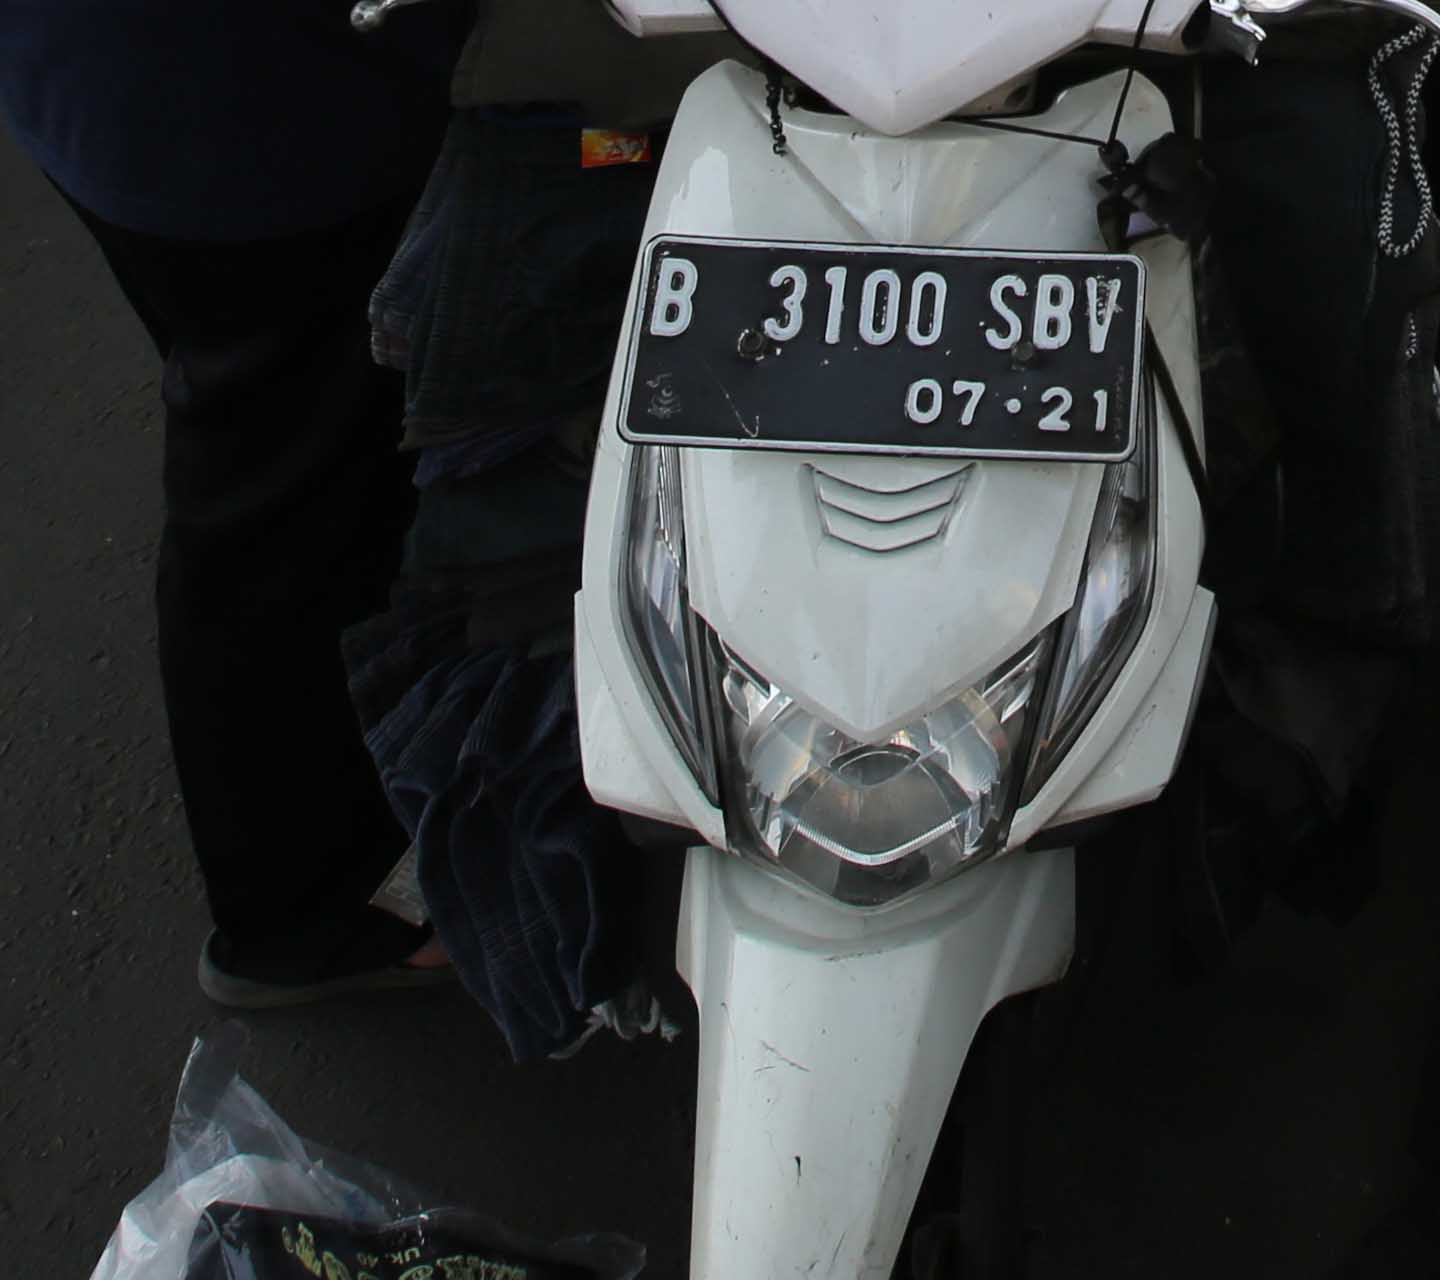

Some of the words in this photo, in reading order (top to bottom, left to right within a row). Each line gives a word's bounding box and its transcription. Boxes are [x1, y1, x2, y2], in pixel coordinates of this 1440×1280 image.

[649, 257, 700, 337] B
[763, 264, 949, 348] 3100
[983, 273, 1123, 354] SBV
